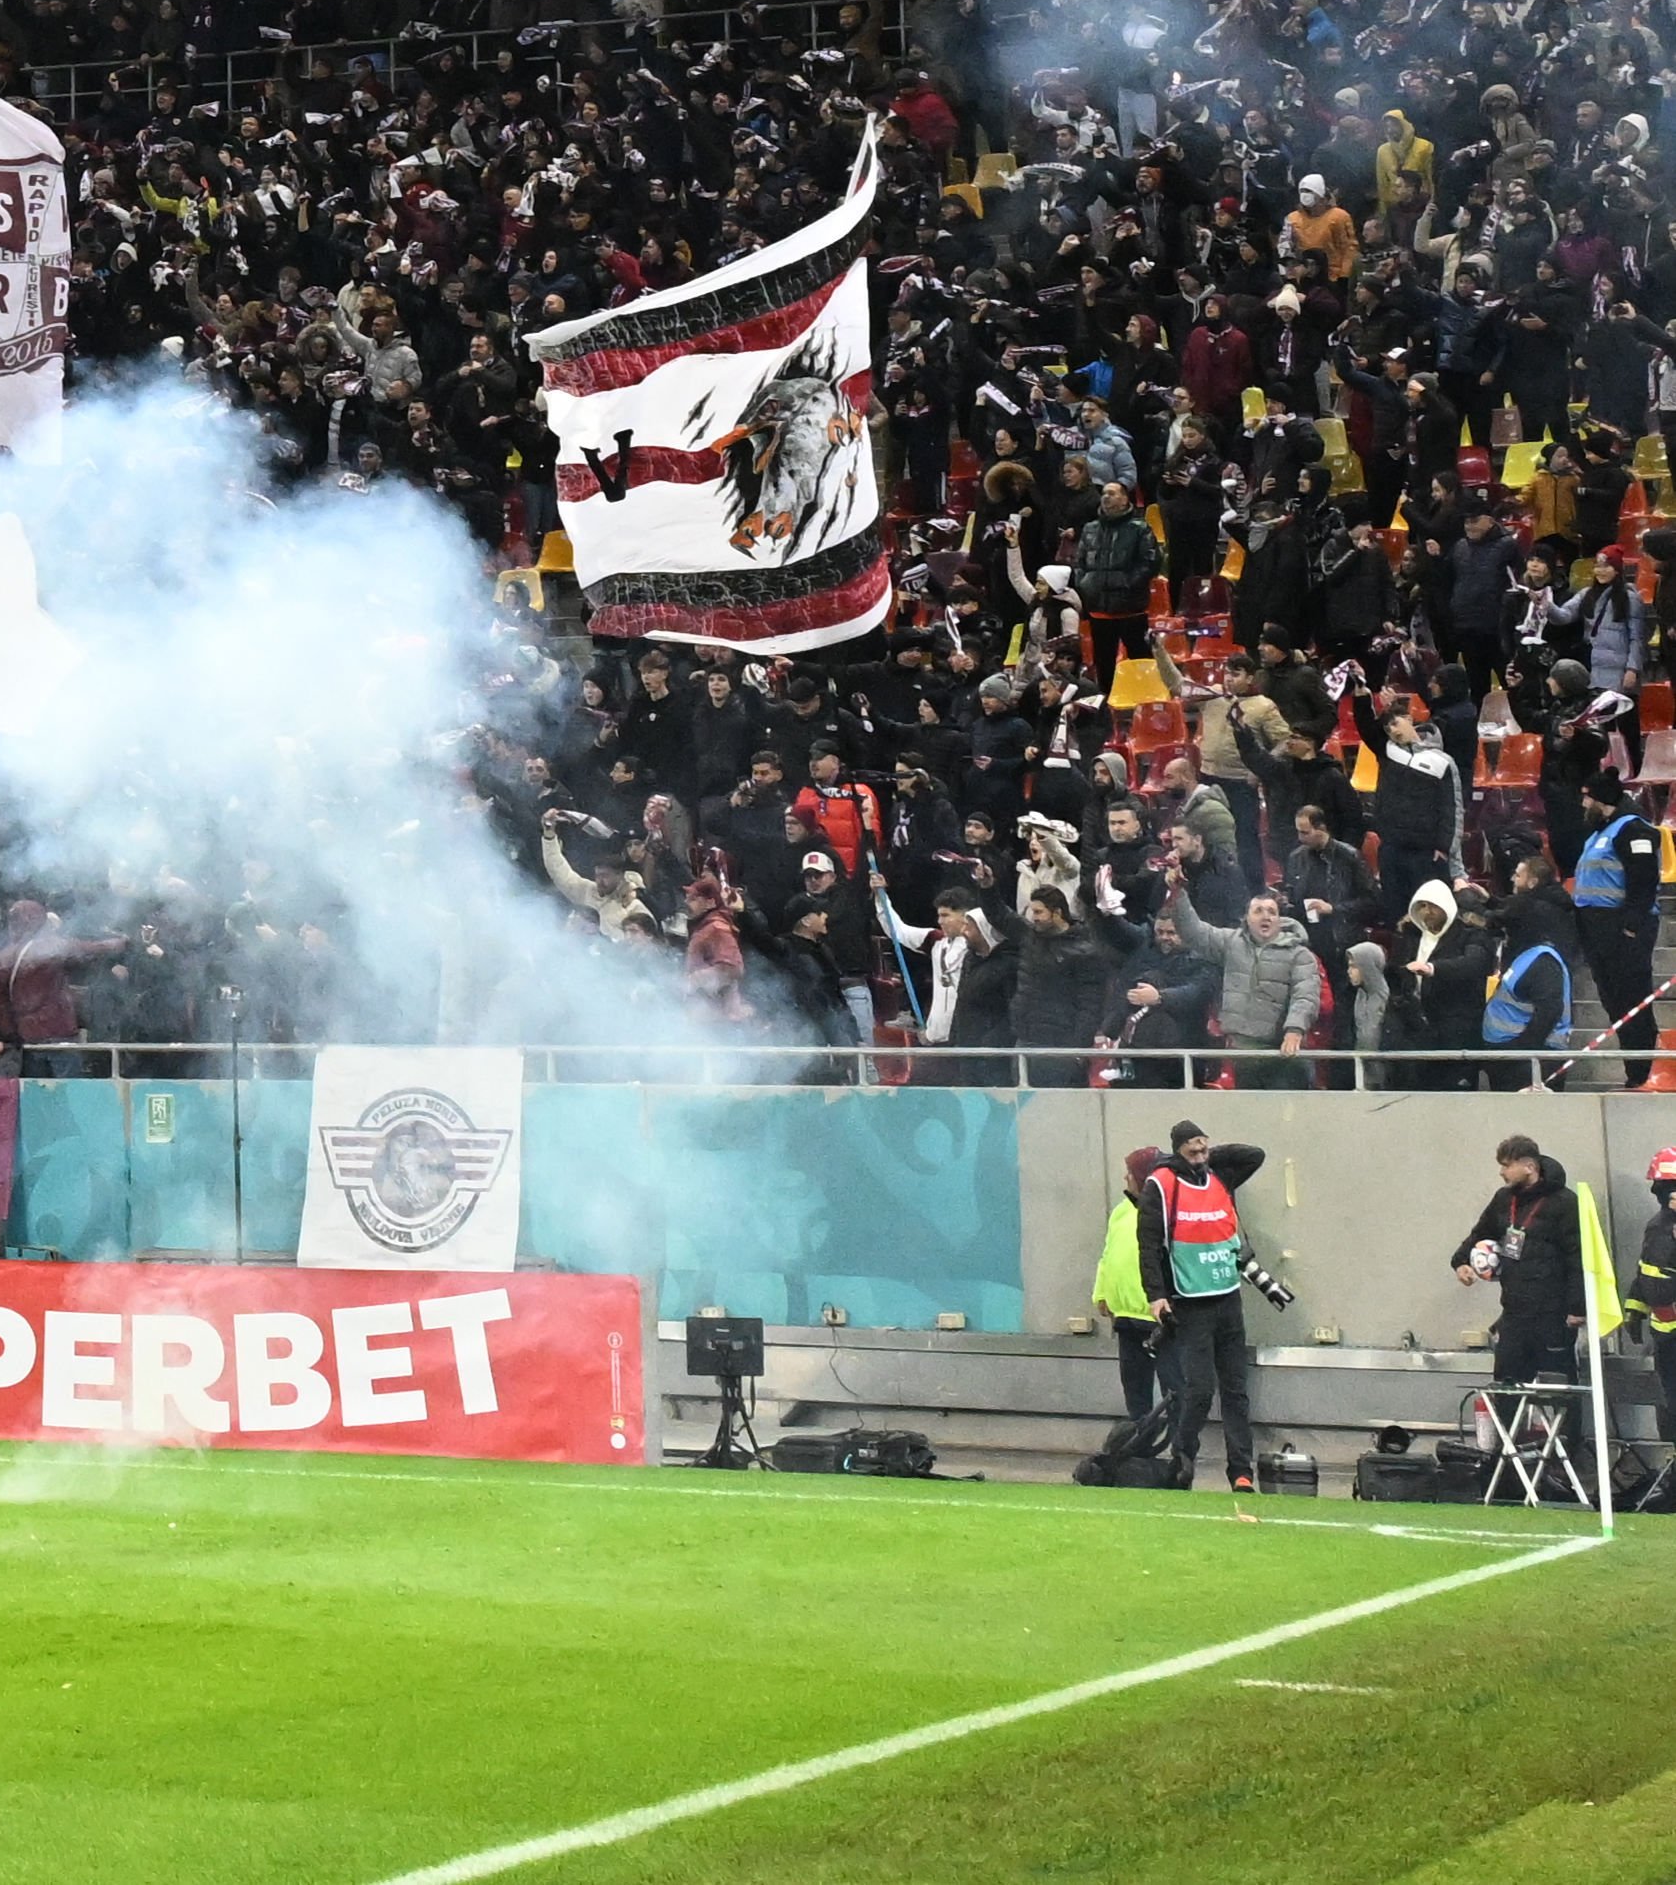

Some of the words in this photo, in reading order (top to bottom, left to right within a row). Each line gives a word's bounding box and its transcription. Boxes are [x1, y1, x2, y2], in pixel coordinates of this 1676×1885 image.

[27, 174, 50, 243] RAPID
[1, 330, 54, 367] 2015
[371, 1096, 422, 1126] PELUZA
